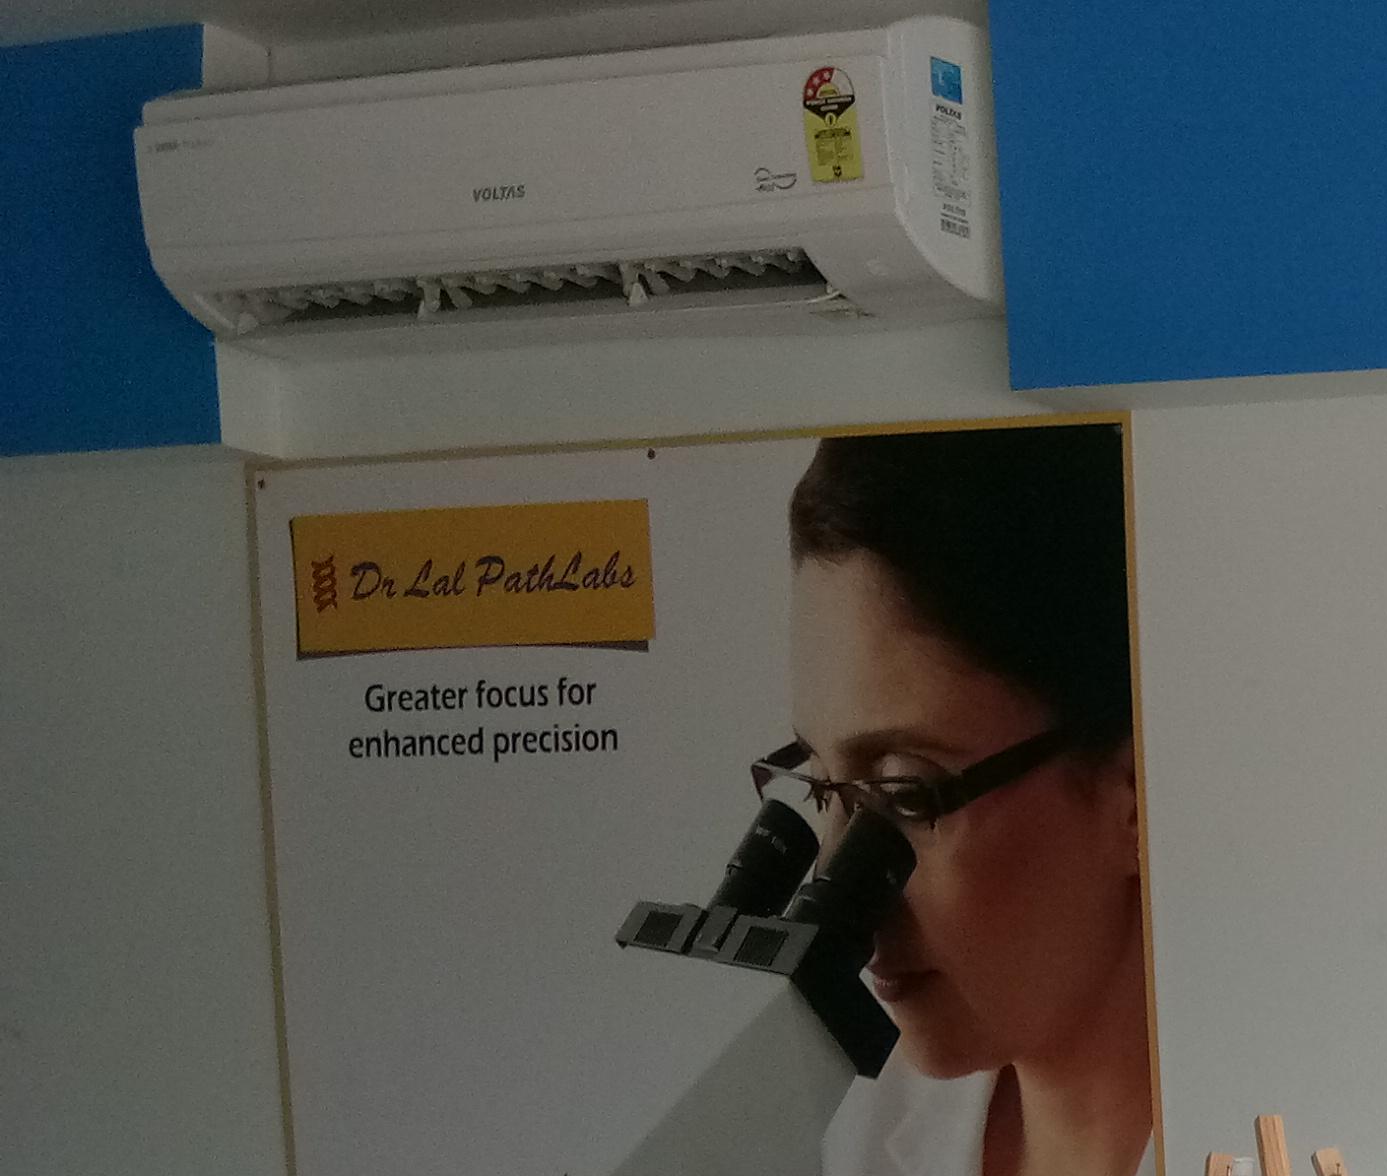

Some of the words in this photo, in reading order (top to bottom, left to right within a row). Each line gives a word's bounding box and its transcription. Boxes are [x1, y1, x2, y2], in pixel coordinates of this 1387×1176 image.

[472, 184, 527, 204] VOLTAS
[350, 560, 398, 602] Dr
[404, 557, 465, 600] Lal
[476, 551, 637, 598] PathLabs
[363, 680, 468, 714] Greater
[475, 677, 550, 710] focus
[556, 675, 598, 708] for
[348, 725, 485, 760] enhanced
[492, 723, 619, 762] precision
